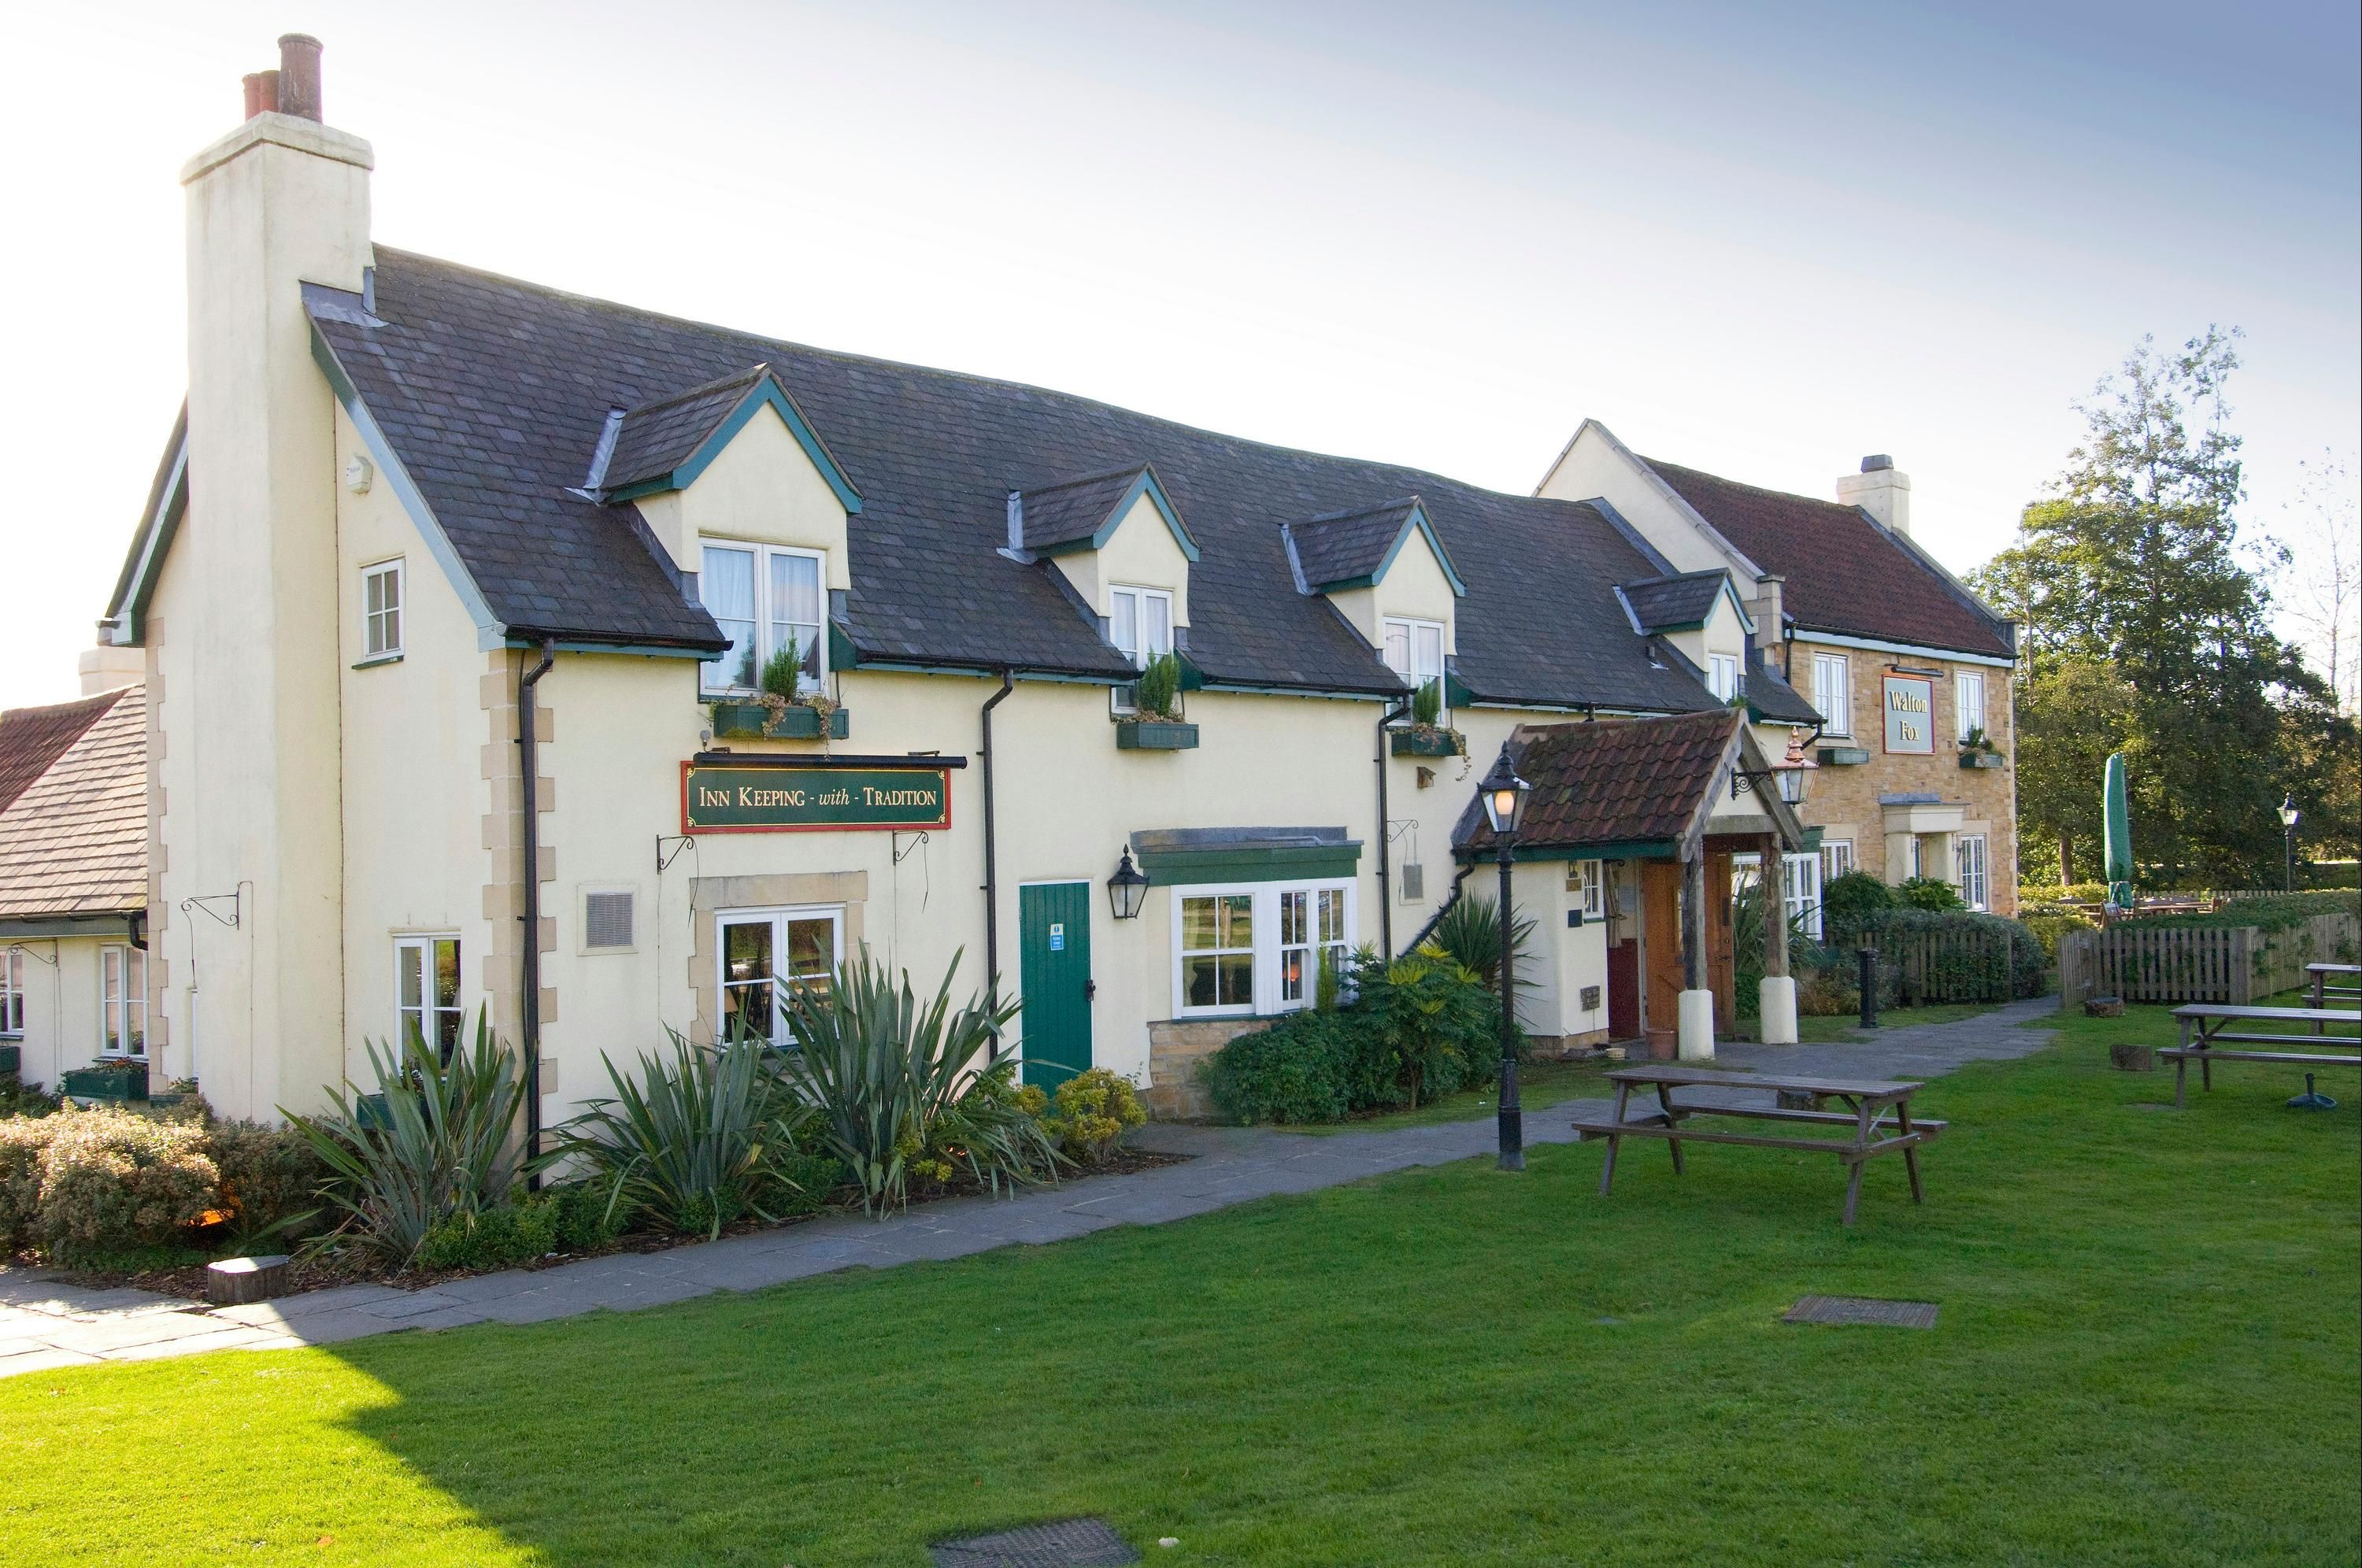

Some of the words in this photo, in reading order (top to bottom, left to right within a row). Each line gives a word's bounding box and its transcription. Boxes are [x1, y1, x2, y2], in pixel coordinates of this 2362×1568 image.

[1890, 691, 1927, 713] Walton
[1899, 721, 1920, 741] Fox
[699, 787, 730, 807] INN
[739, 787, 805, 807] KEEPING
[819, 788, 850, 805] with
[863, 787, 936, 806] TRADITION
